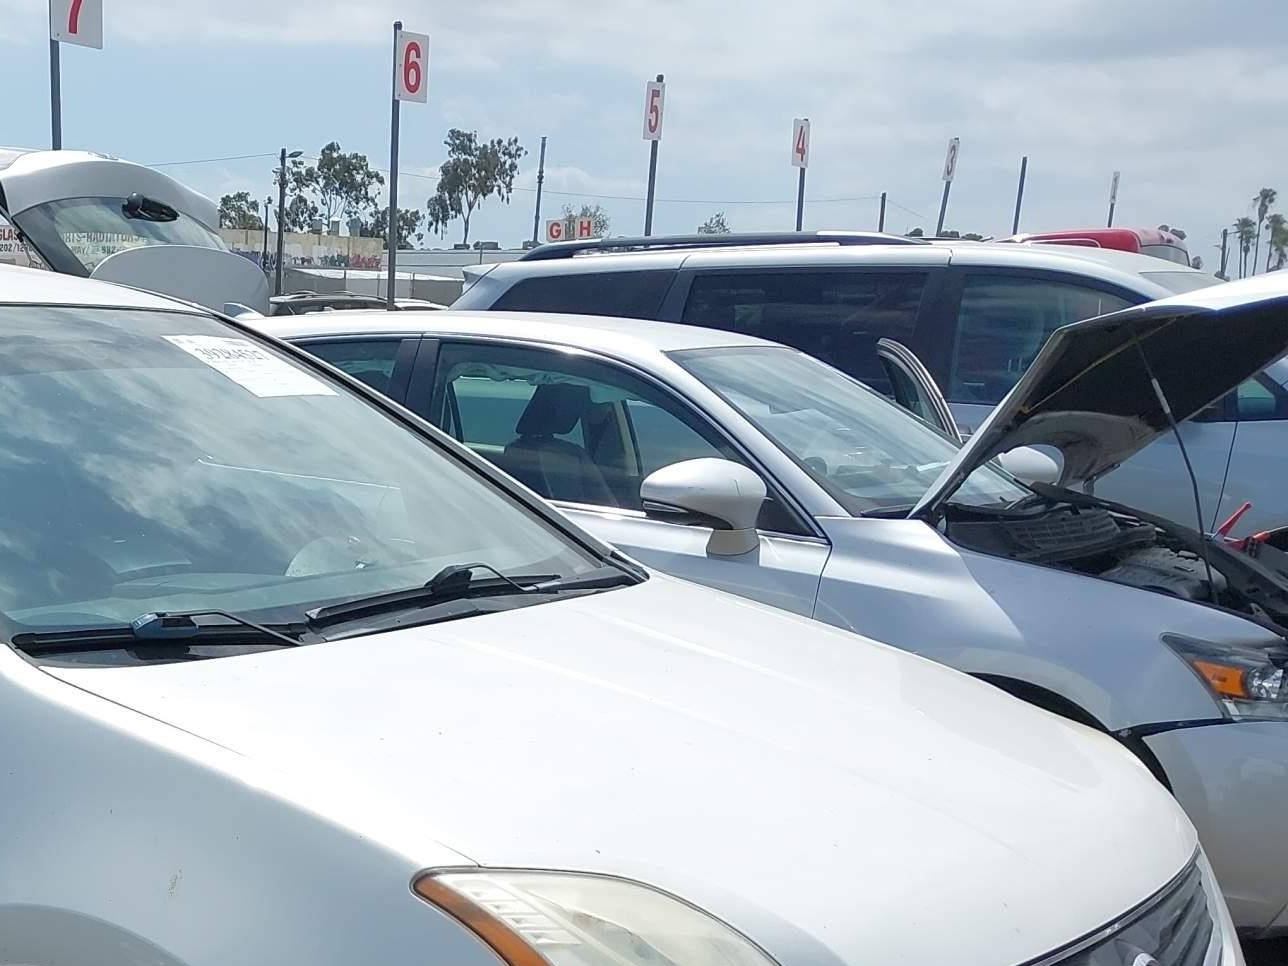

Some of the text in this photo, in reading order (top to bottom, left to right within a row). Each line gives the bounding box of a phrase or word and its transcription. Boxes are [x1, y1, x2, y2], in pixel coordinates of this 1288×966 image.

[404, 41, 421, 93] 6
[648, 89, 661, 133] 5
[795, 125, 806, 162] 4
[549, 222, 562, 239] G
[579, 220, 592, 238] H
